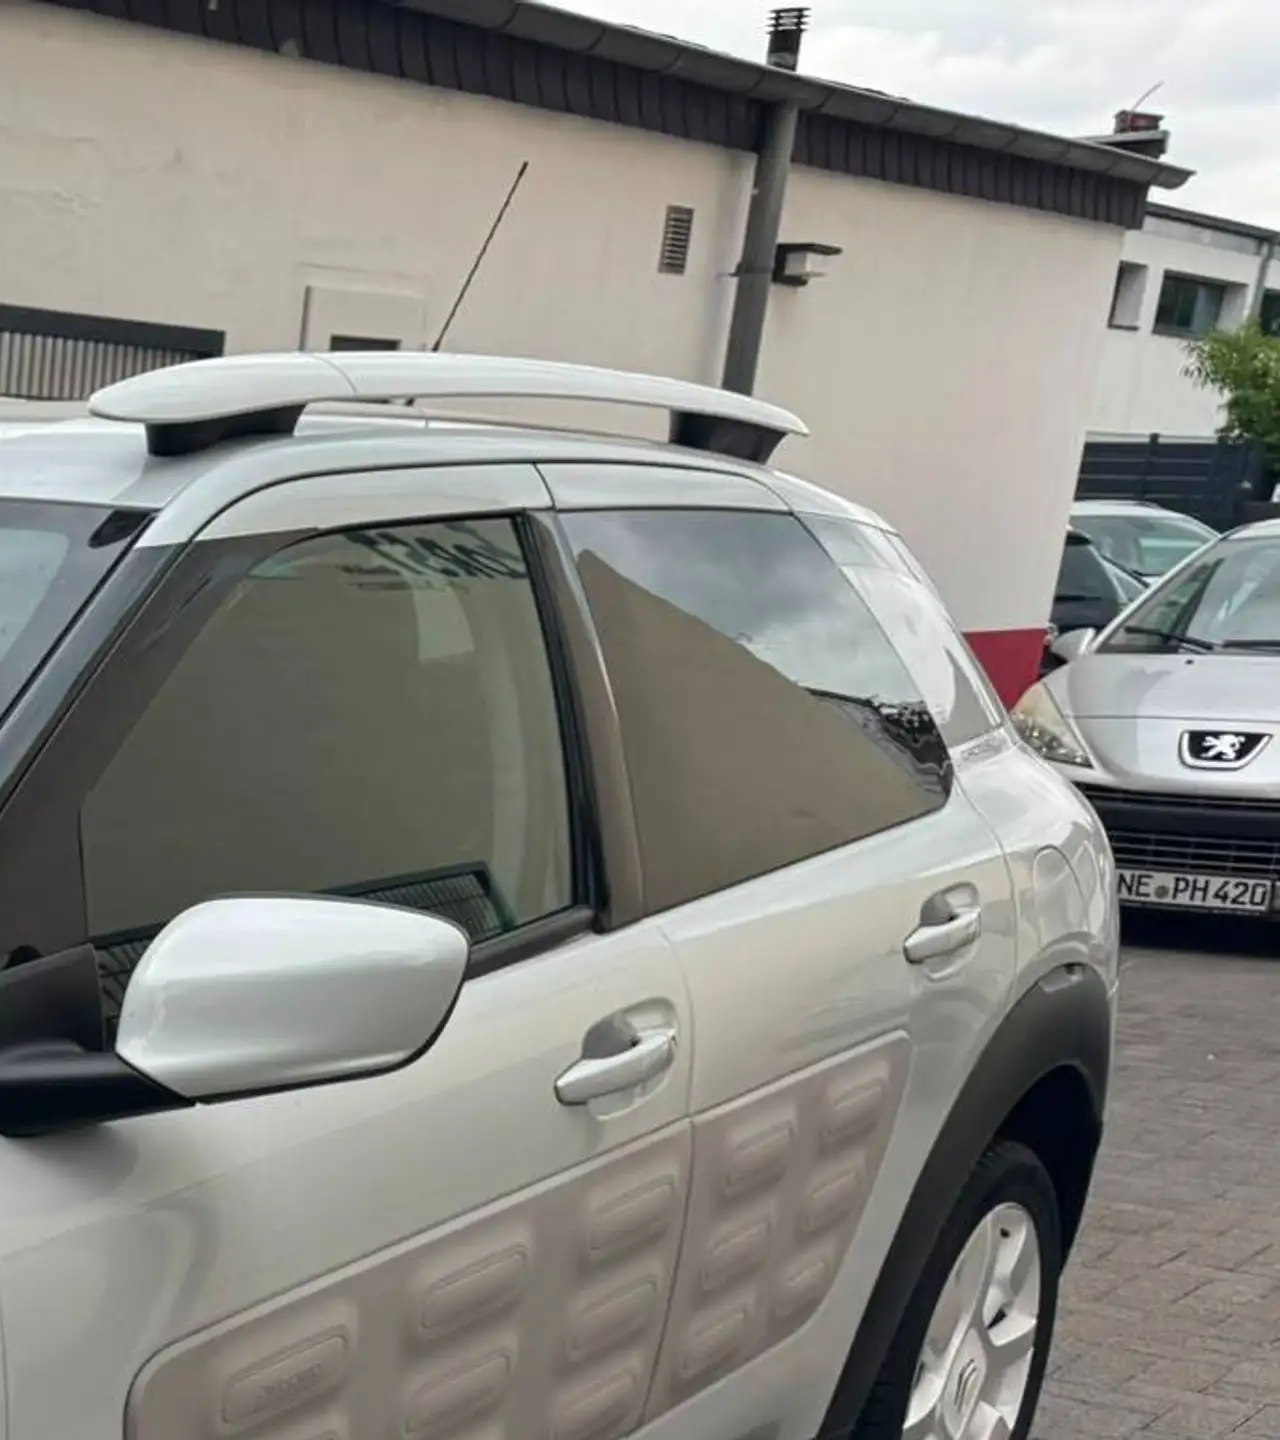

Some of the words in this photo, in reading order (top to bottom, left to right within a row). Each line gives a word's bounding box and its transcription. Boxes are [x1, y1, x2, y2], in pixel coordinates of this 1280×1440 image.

[1117, 872, 1154, 898] NE
[1172, 876, 1210, 902] PH
[1212, 880, 1268, 907] 420
